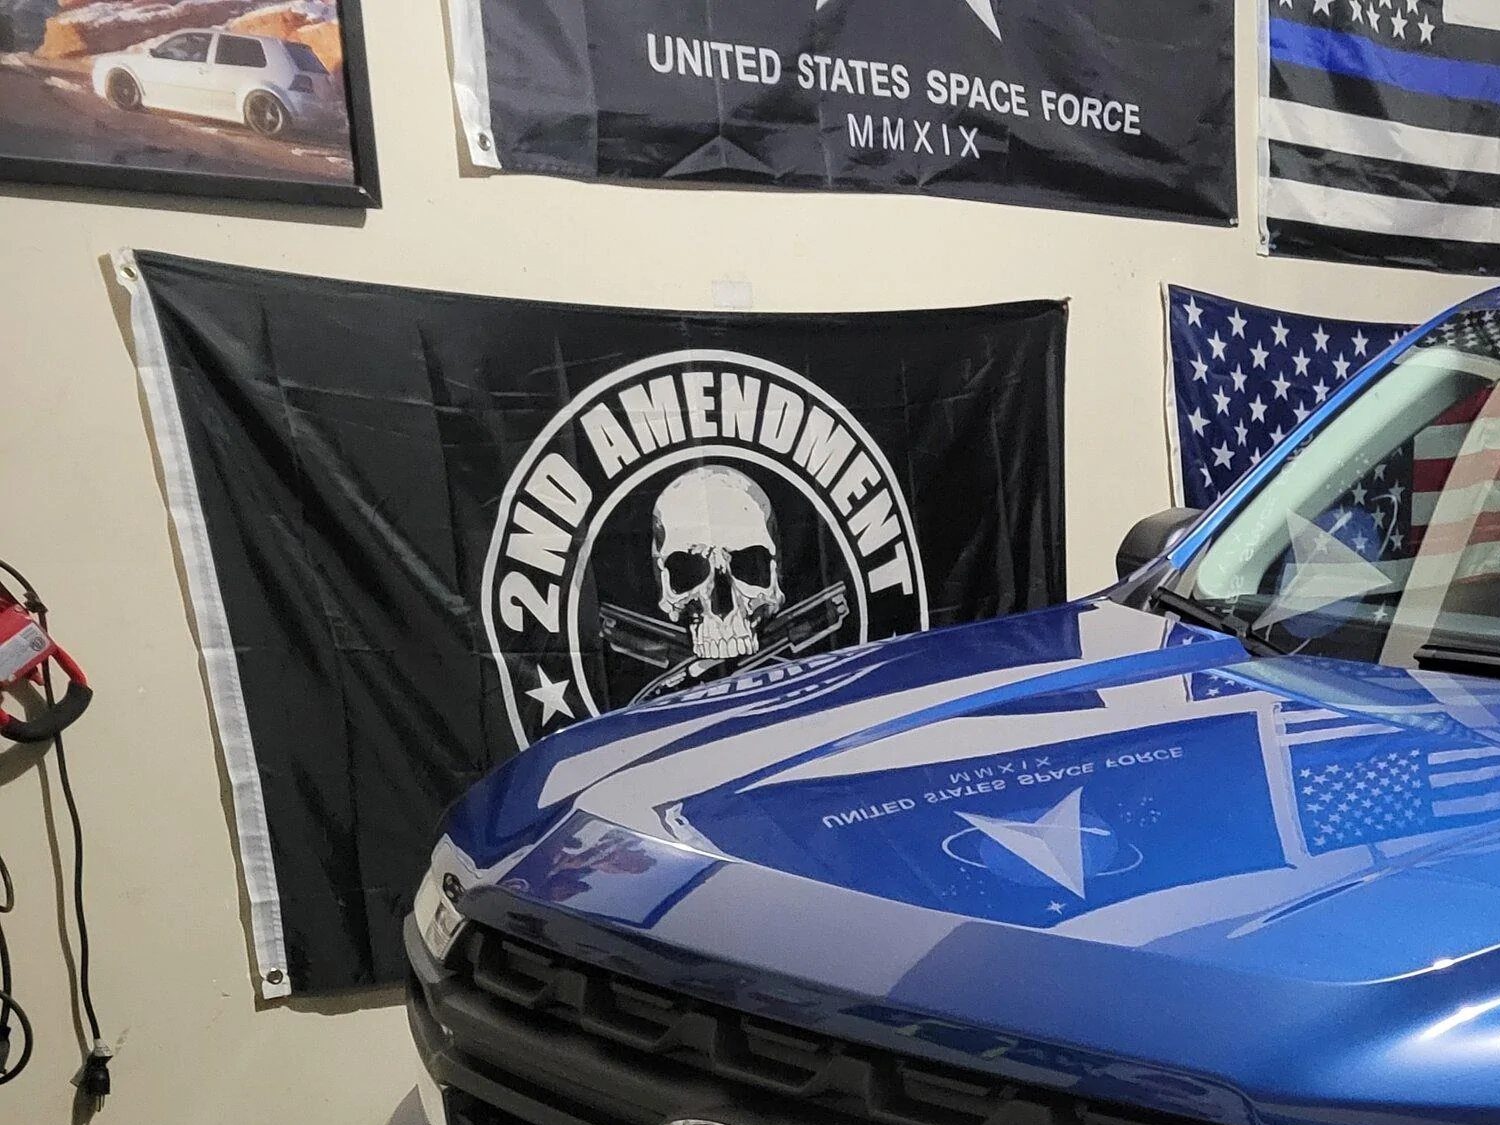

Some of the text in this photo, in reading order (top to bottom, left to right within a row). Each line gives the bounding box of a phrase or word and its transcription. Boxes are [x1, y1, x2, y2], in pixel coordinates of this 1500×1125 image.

[647, 33, 1141, 135] UNITED STATES SPACE FORCE
[847, 113, 980, 159] MMXIX
[500, 371, 913, 633] 2ND AMENDMENT
